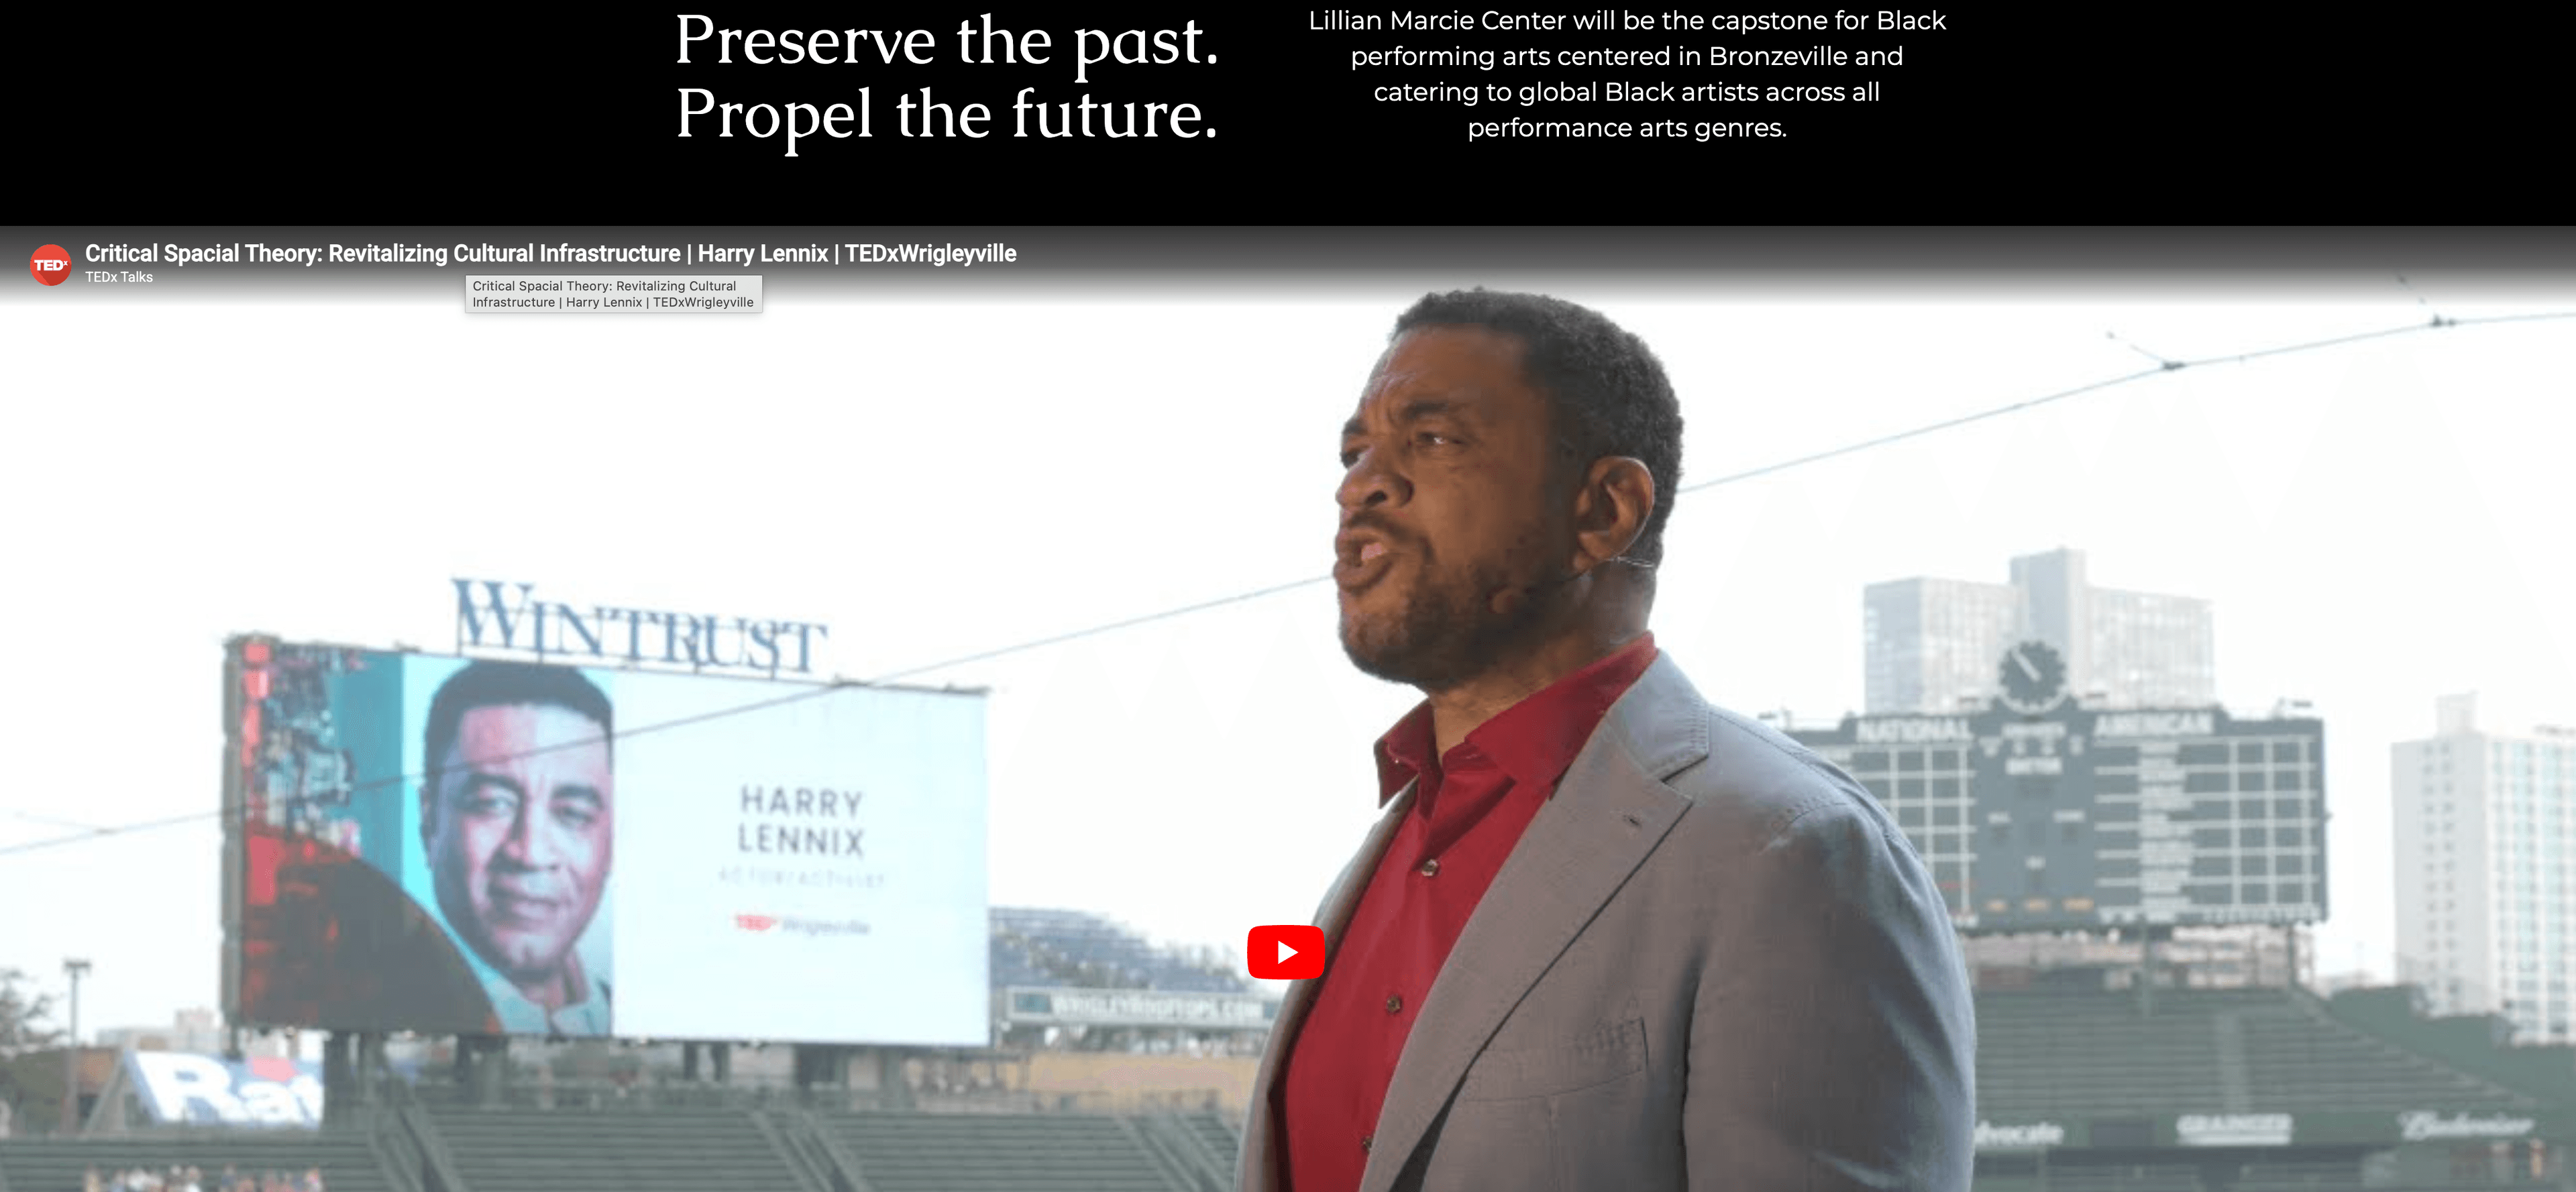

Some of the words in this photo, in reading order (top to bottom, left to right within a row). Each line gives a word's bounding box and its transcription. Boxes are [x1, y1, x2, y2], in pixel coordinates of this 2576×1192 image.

[450, 578, 830, 673] WINTRUST
[1856, 718, 1974, 744] NATIONAL
[741, 783, 863, 818] HARRY
[738, 822, 866, 857] LENNIX
[1974, 1120, 2065, 1146] dvocate
